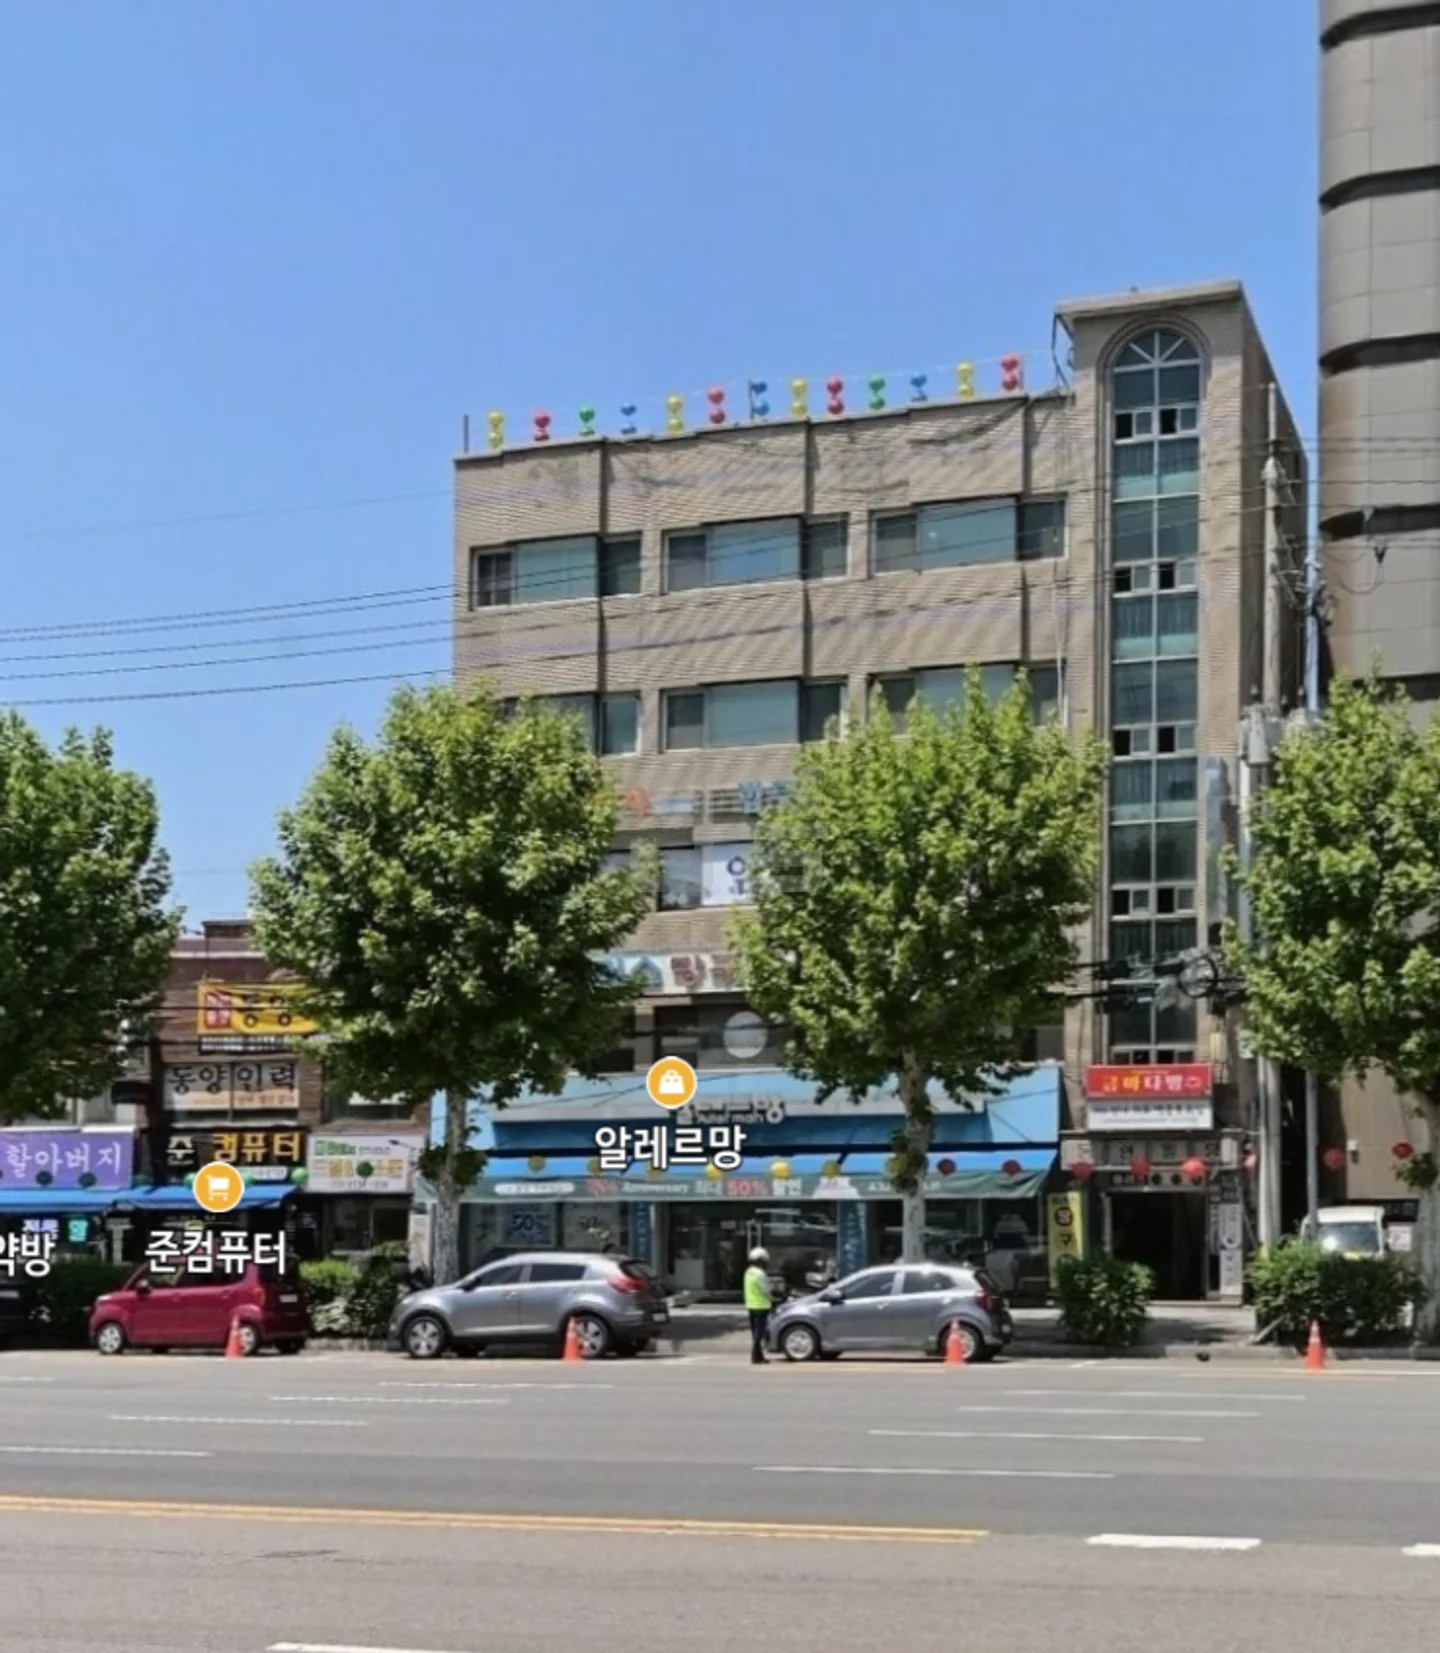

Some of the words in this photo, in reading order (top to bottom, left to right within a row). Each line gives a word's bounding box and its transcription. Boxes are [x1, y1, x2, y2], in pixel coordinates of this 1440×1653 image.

[168, 1063, 295, 1095] 동양인력
[5, 1140, 122, 1178] 할아버지
[166, 1134, 195, 1165] 준
[212, 1131, 301, 1163] 컴퓨터
